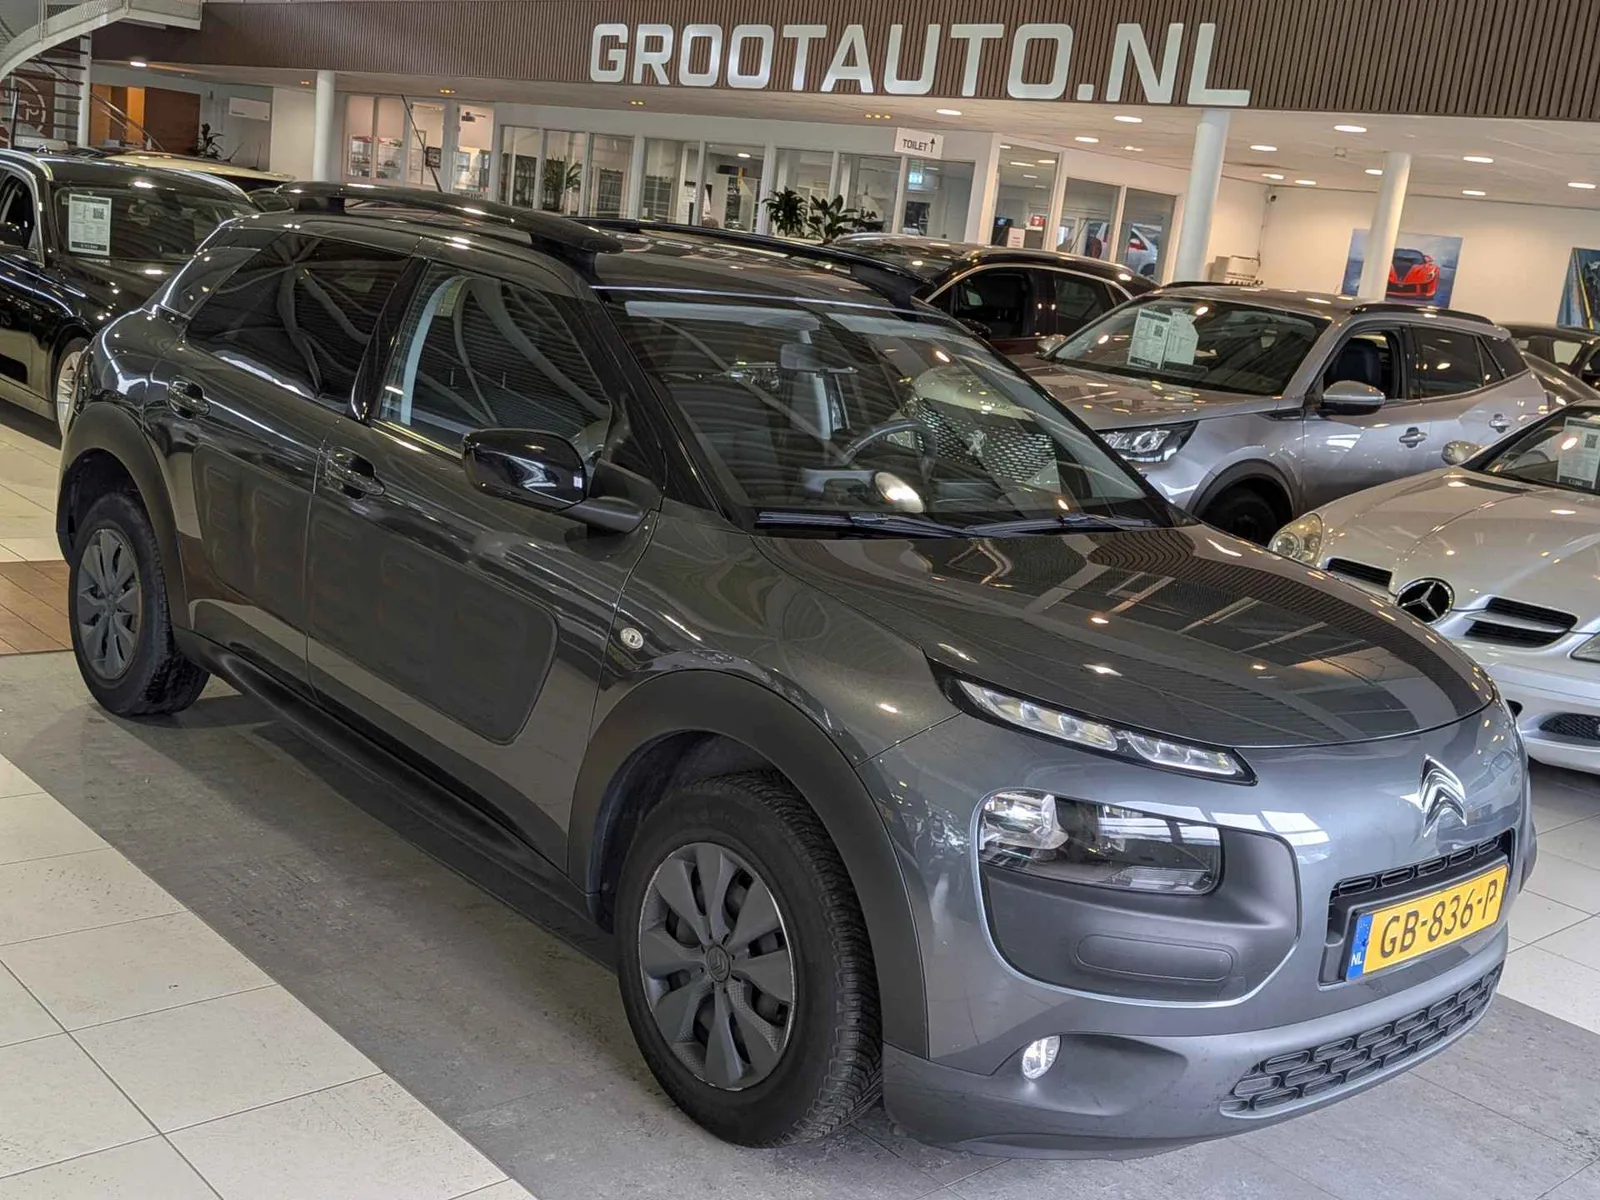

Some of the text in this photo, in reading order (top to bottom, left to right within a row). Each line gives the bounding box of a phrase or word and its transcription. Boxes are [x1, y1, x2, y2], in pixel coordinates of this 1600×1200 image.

[590, 23, 1250, 106] GROOTAUTO.NL
[902, 138, 928, 152] TOILET
[1380, 879, 1498, 958] GB-836-P
[1350, 952, 1363, 966] NL
